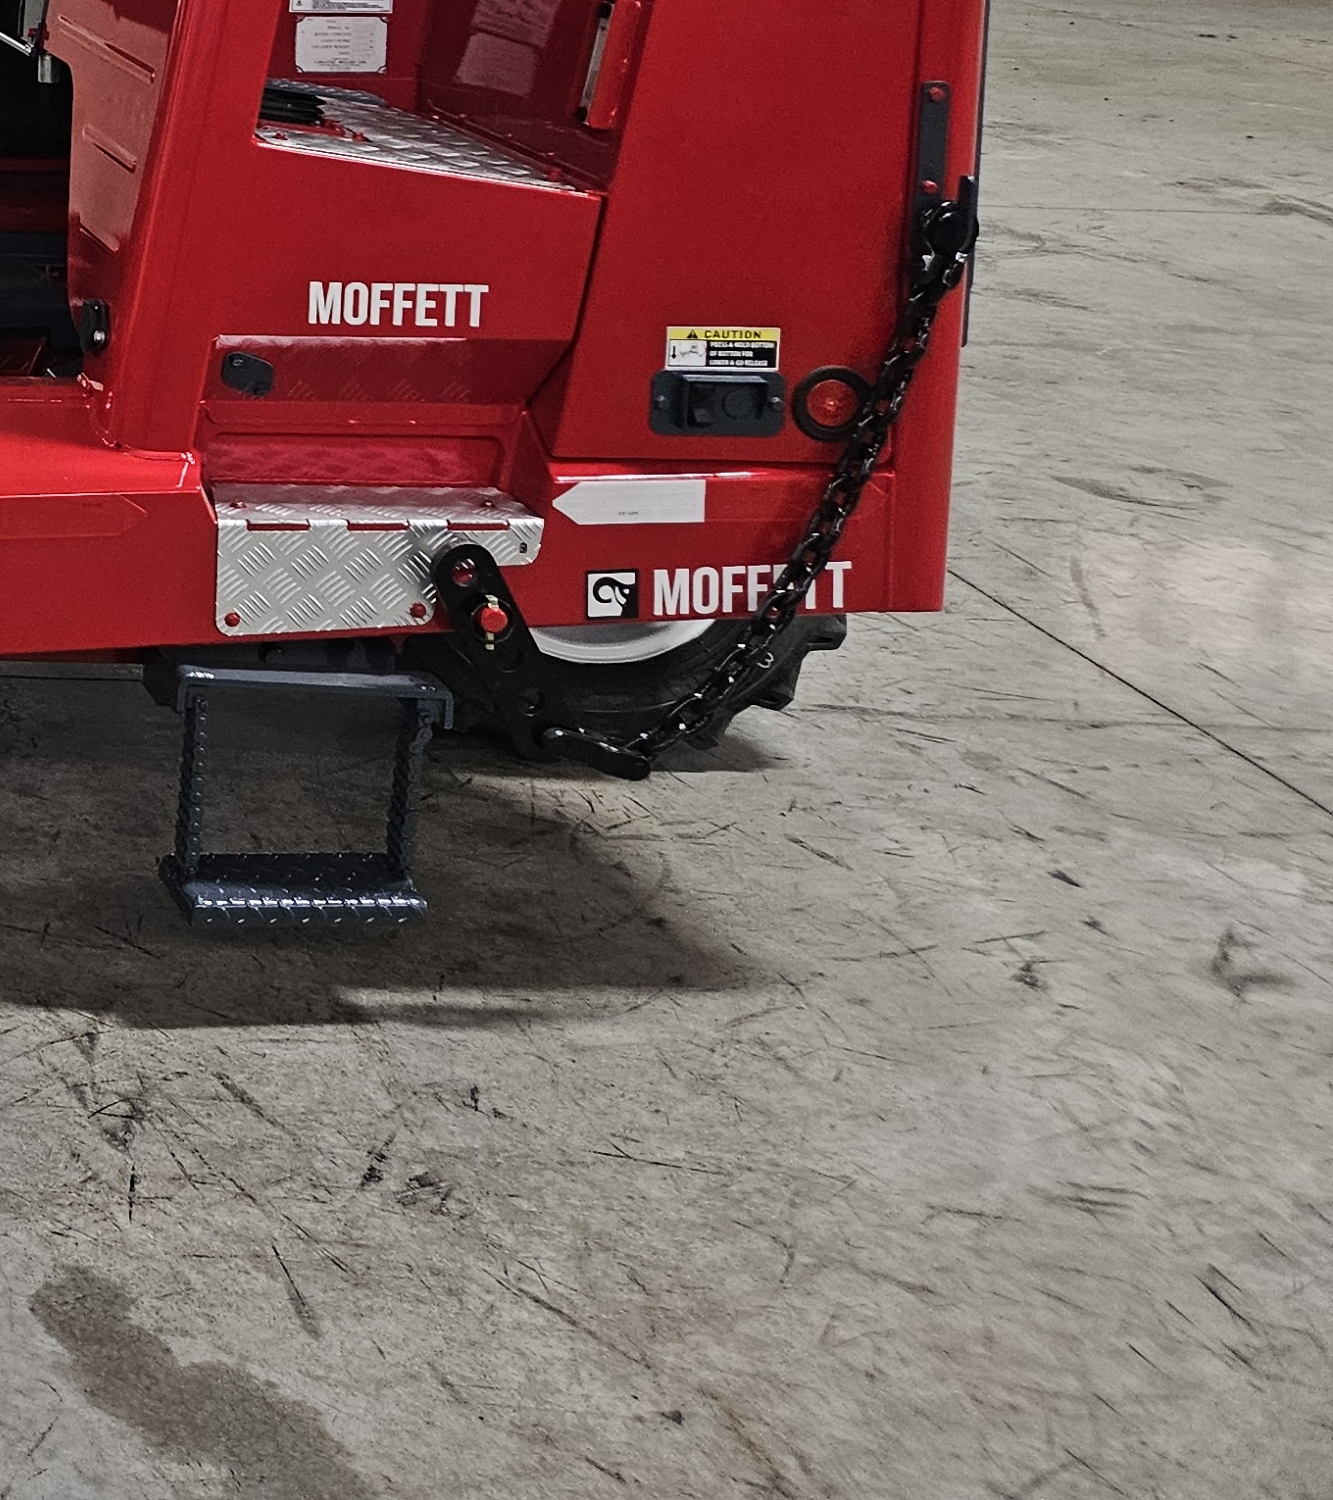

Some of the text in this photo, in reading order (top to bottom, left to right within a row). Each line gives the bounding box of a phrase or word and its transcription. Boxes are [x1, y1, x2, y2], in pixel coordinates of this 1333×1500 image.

[308, 281, 489, 328] MOFFETT
[704, 330, 762, 339] CAUTION
[653, 560, 852, 616] MOFFT
